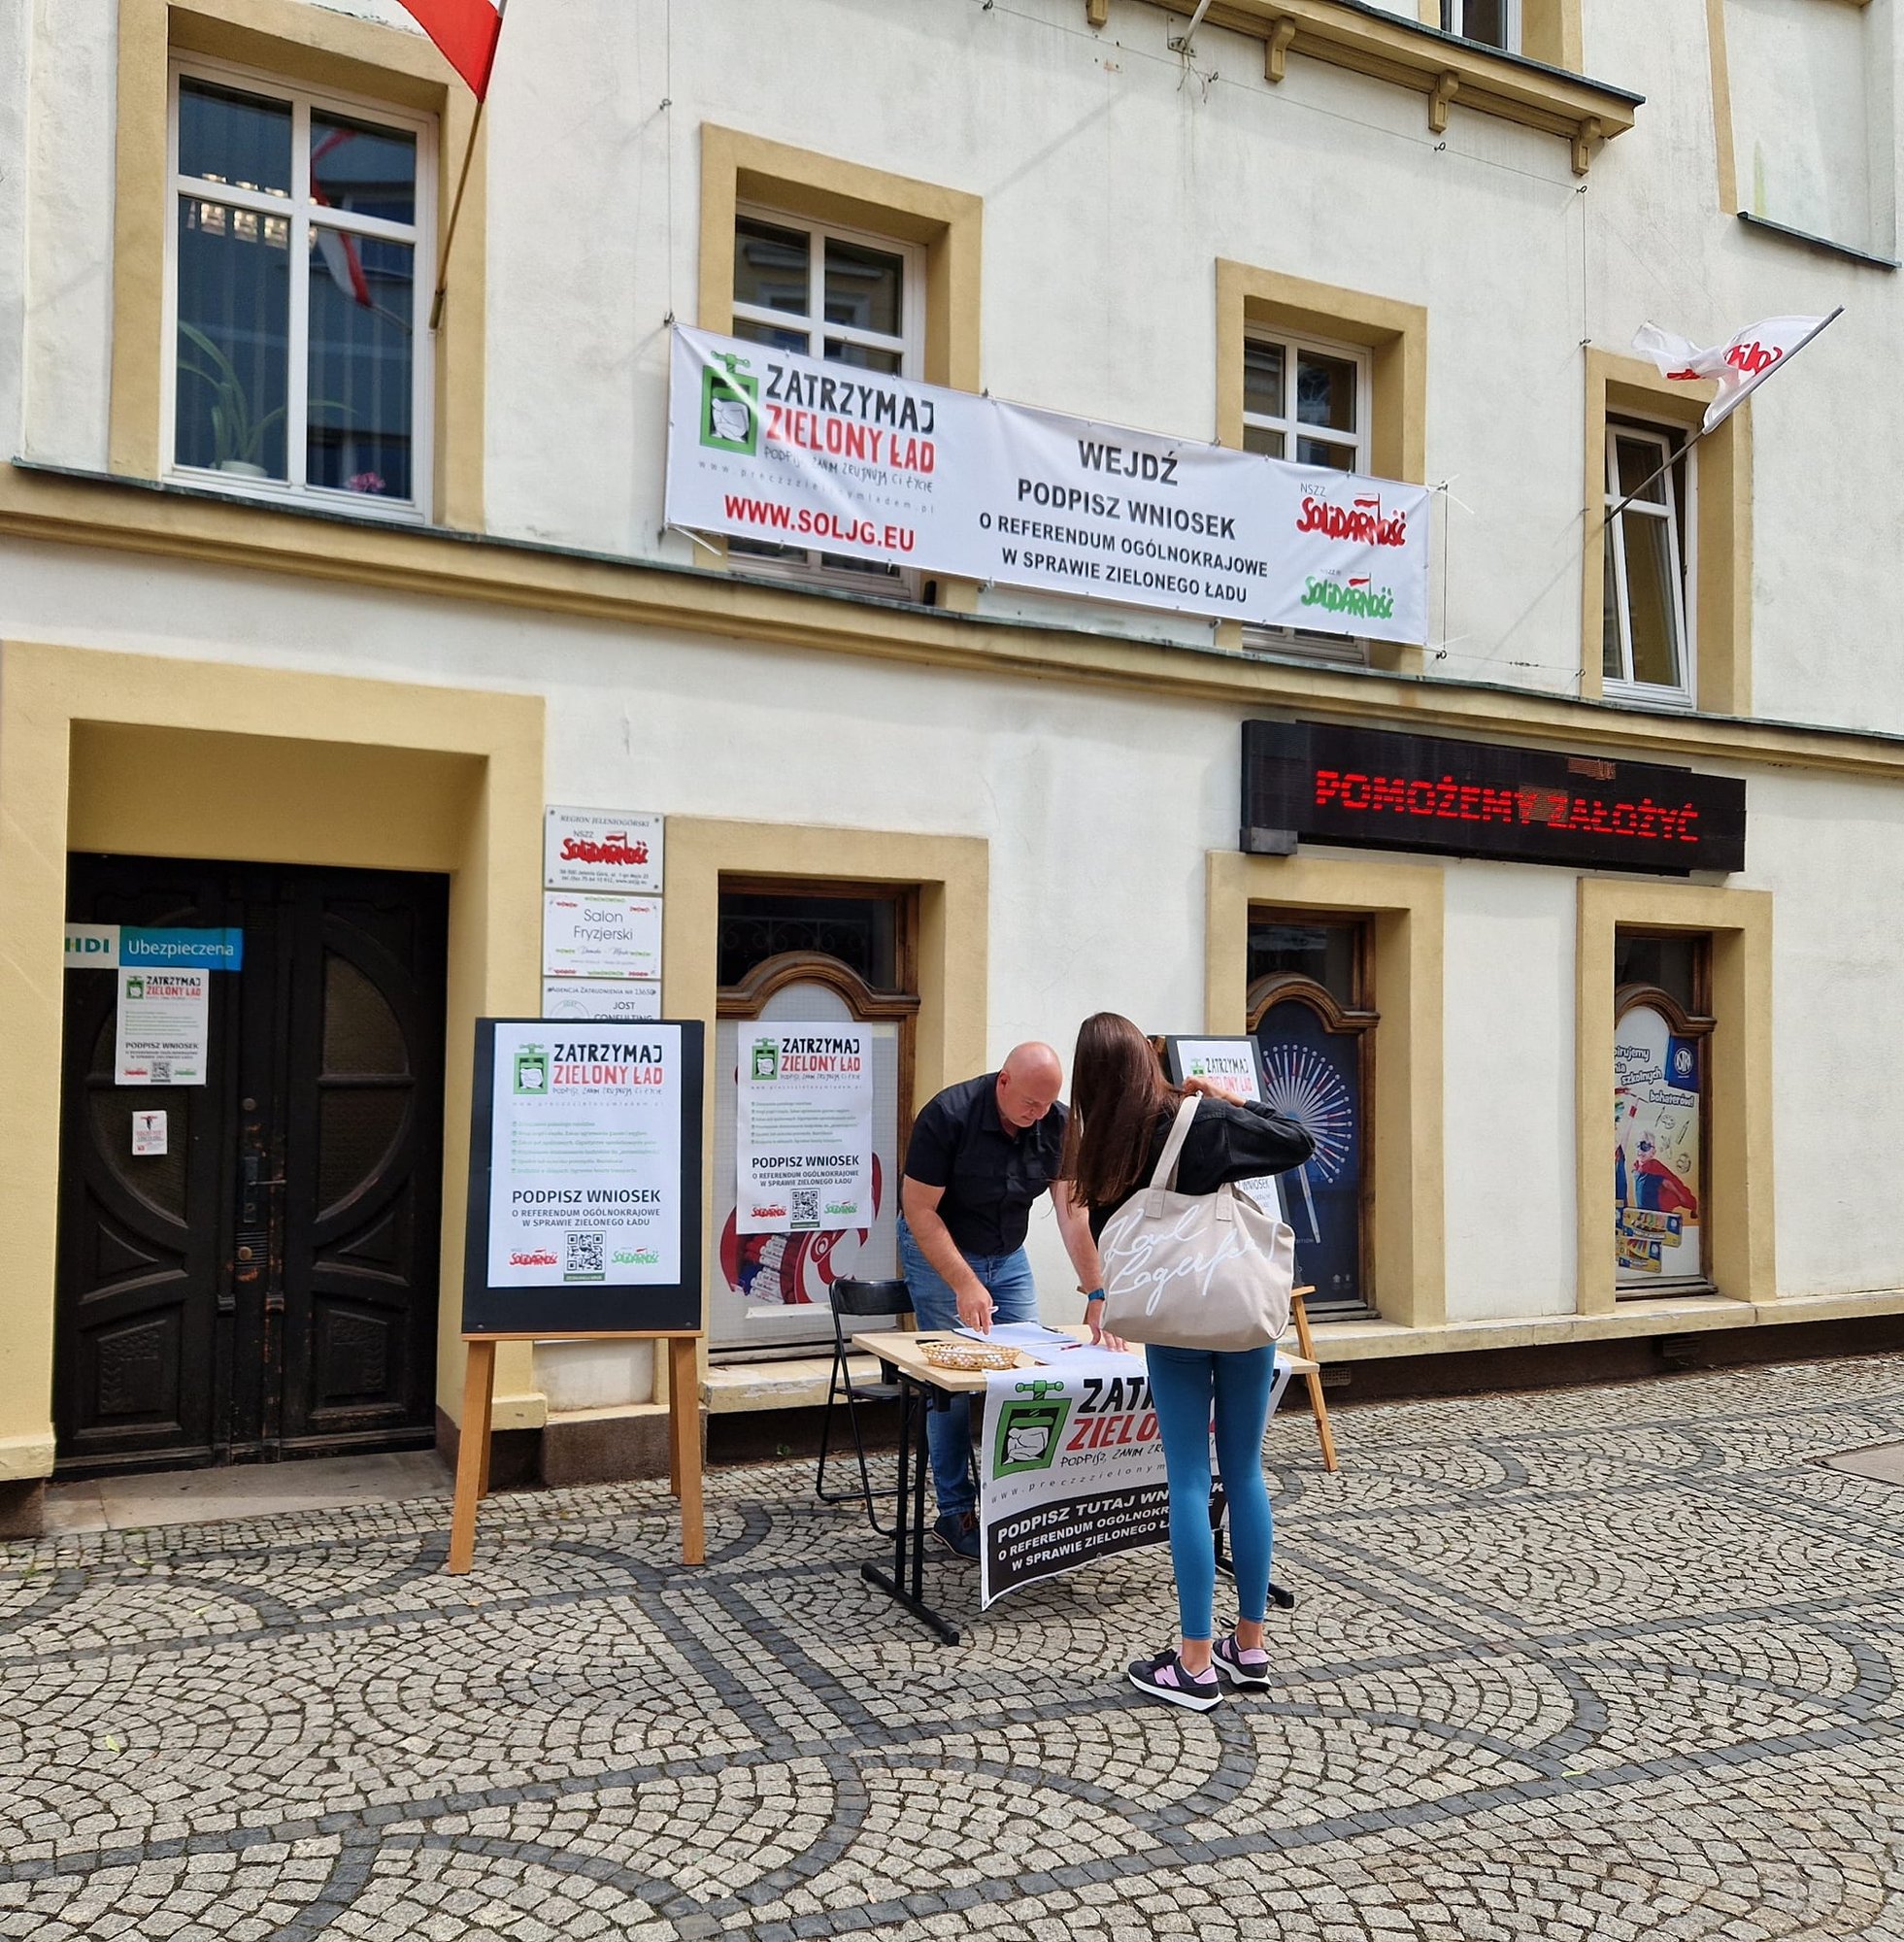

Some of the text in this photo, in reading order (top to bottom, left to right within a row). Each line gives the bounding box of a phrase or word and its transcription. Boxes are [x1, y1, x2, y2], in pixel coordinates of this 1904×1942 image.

[766, 363, 934, 434] ZATRZYMAJ
[766, 404, 935, 474] ZIELONY ŁAD
[1078, 439, 1179, 486] WEJDŹ
[1300, 483, 1326, 497] NSZZ
[1018, 478, 1236, 540] PODPISZ WNIOSEK
[724, 494, 915, 552] WWW.SOLJG.EU
[979, 512, 1268, 578] O REFERENDUM OGÓLNOKRAJOWE
[1001, 548, 1248, 603] W SPRAWIE ZIELONEGO ŁADU
[1316, 770, 1538, 824] POMOŻEMY
[584, 909, 623, 922] Salon
[573, 925, 633, 942] Fryzjerski
[147, 976, 201, 987] ZATRZYMAJ
[147, 987, 184, 996] ZIELONY
[613, 1001, 636, 1010] JOST
[553, 1044, 662, 1063] ZATRZYMAJ
[782, 1038, 859, 1055] ZATRZYMAJ
[782, 1055, 861, 1072] ZIELONY ŁAD
[1206, 1057, 1250, 1073] ZATRZYMAJ
[553, 1065, 664, 1085] ZIELONY ŁAD
[1621, 1066, 1662, 1085] szkolnych
[752, 1155, 859, 1168] PODPISZ WNIOSEK
[512, 1189, 661, 1203] PODPISZ WNIOSEK
[583, 1208, 661, 1217] OGÓLNOKRAJOWE
[1066, 1413, 1162, 1453] ZIELO
[1111, 1447, 1144, 1460] ZANIM
[997, 1505, 1070, 1544] PODPISZ
[1076, 1495, 1135, 1518] TUTAJ
[997, 1549, 1007, 1561] O
[1010, 1521, 1093, 1557] REFERENDUM
[1096, 1505, 1170, 1528] OGÓLNOKR
[1012, 1522, 1156, 1571] W SPRAWIE ZIELONEGO
